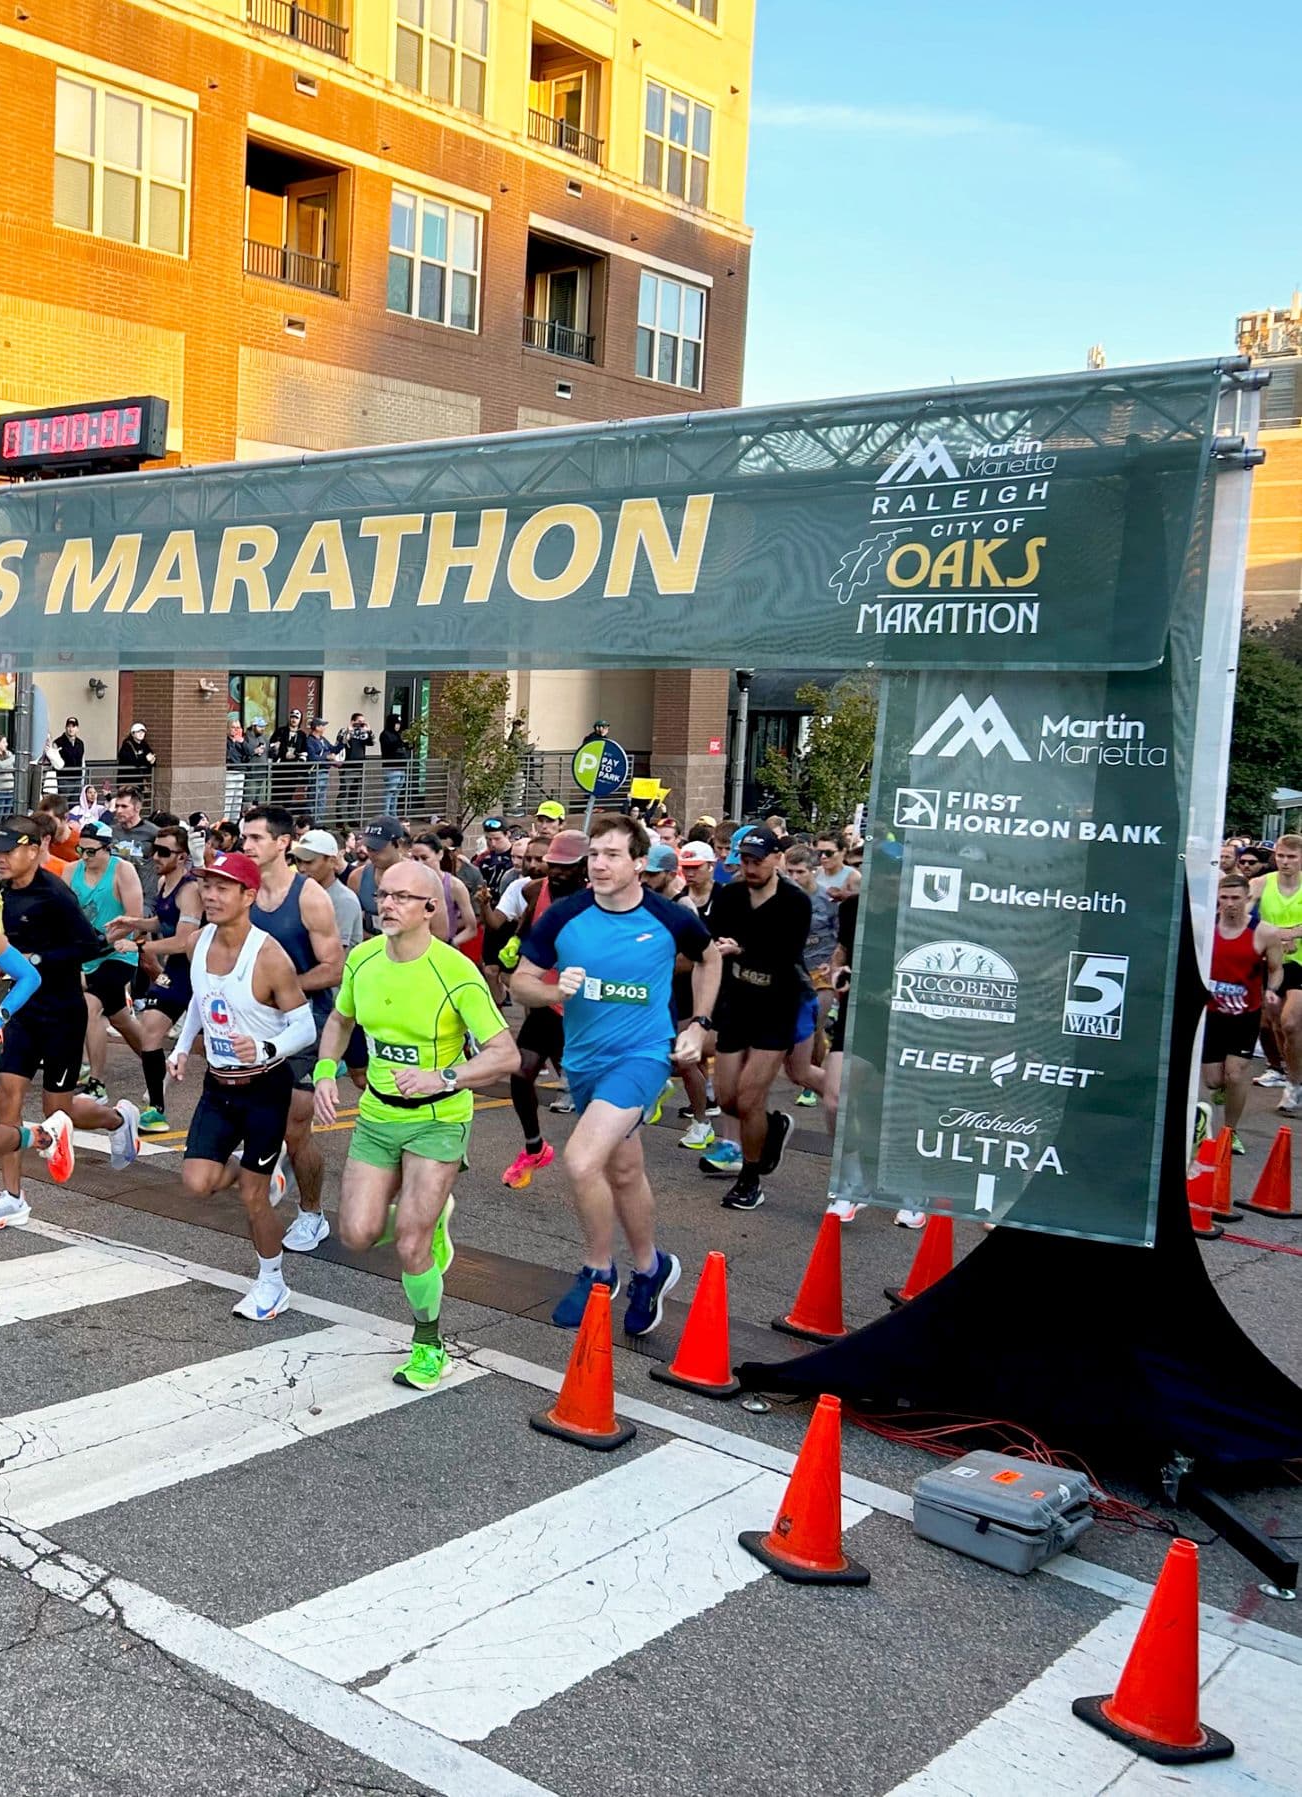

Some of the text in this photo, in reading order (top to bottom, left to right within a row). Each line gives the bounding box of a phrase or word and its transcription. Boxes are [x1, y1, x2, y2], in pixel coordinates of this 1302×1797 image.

[2, 406, 142, 459] 07:00:02
[968, 439, 1042, 459] Martin
[965, 453, 1058, 477] Marietta
[872, 481, 1049, 515] RALEIGH
[930, 518, 1025, 537] CITY OF
[43, 493, 715, 616] MARATHON
[886, 537, 1047, 588] OAKS
[856, 602, 1040, 634] MARATHON
[1041, 713, 1145, 739] Martin
[578, 753, 597, 773] P
[602, 758, 620, 767] PAY
[1038, 740, 1167, 767] Marietta
[598, 771, 620, 782] PARK
[947, 791, 1022, 813] FIRST
[944, 815, 1163, 845] HORIZON BANK
[969, 882, 1127, 914] DukeHealth
[605, 983, 648, 1000] 9403
[892, 972, 1018, 1002] RICCOBENE
[1066, 957, 1127, 1017] 5
[894, 1001, 1013, 1022] FAMILY DENTISTRY
[919, 993, 1017, 1009] ASSOCIATES
[1066, 1014, 1119, 1037] WRAL
[382, 1048, 418, 1063] 433
[899, 1048, 1094, 1088] FLEET FEET
[938, 1107, 1042, 1135] Michelob
[916, 1129, 1065, 1176] ULTRA
